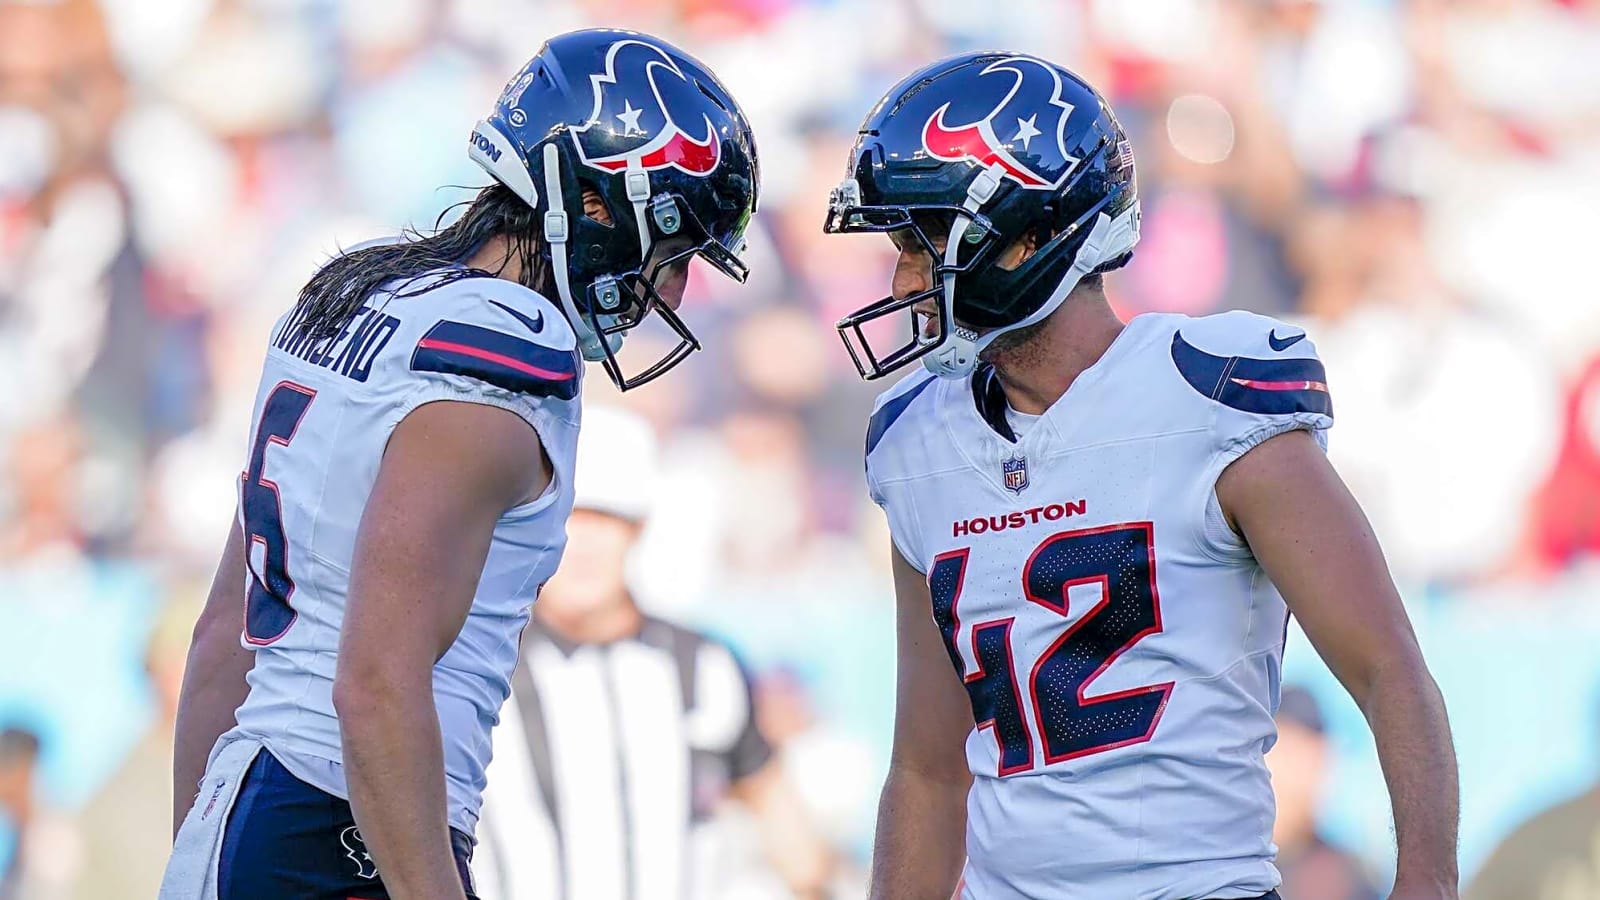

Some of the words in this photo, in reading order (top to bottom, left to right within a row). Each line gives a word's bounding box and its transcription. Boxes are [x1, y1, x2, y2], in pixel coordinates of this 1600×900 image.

[242, 382, 318, 645] 6
[954, 499, 1087, 537] HOUSTON
[1006, 472, 1025, 487] NFL
[928, 521, 1175, 777] 42
